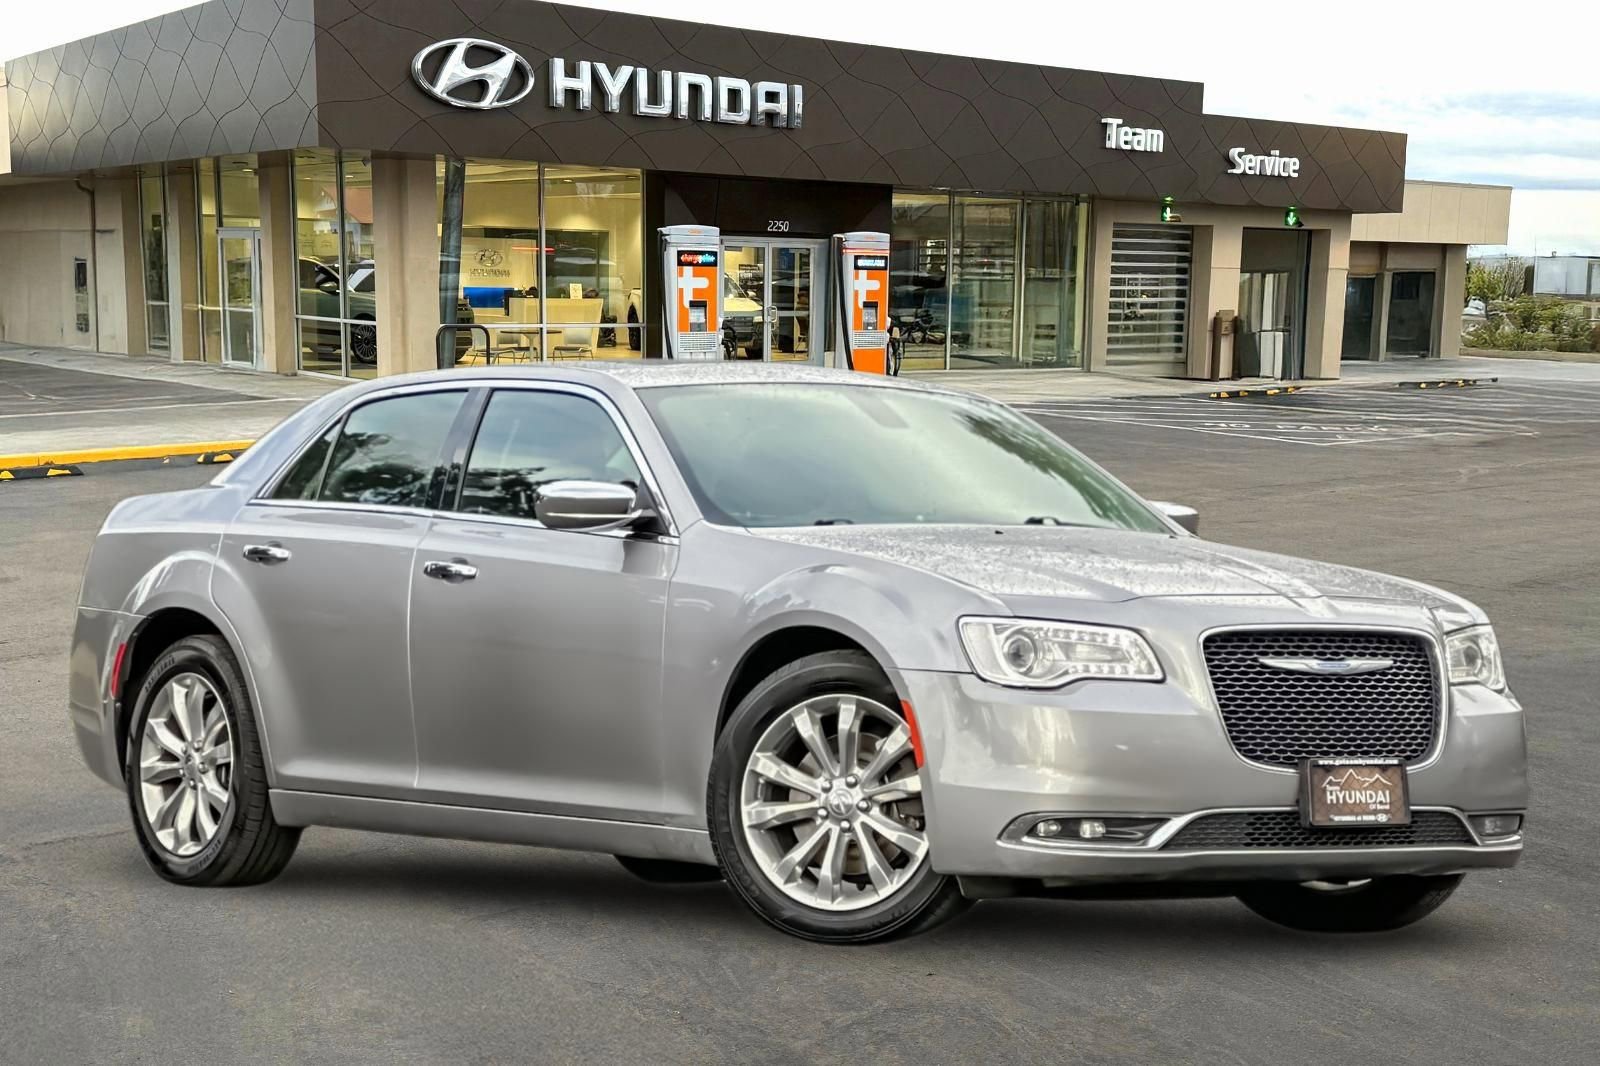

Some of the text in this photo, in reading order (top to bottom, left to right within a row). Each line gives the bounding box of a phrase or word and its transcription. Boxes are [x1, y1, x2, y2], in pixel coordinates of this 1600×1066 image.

[548, 57, 803, 128] HYUNDAI
[1101, 117, 1164, 152] Team
[1227, 147, 1300, 177] Service
[767, 220, 790, 232] 2250
[1326, 790, 1390, 804] HYUNDAI
